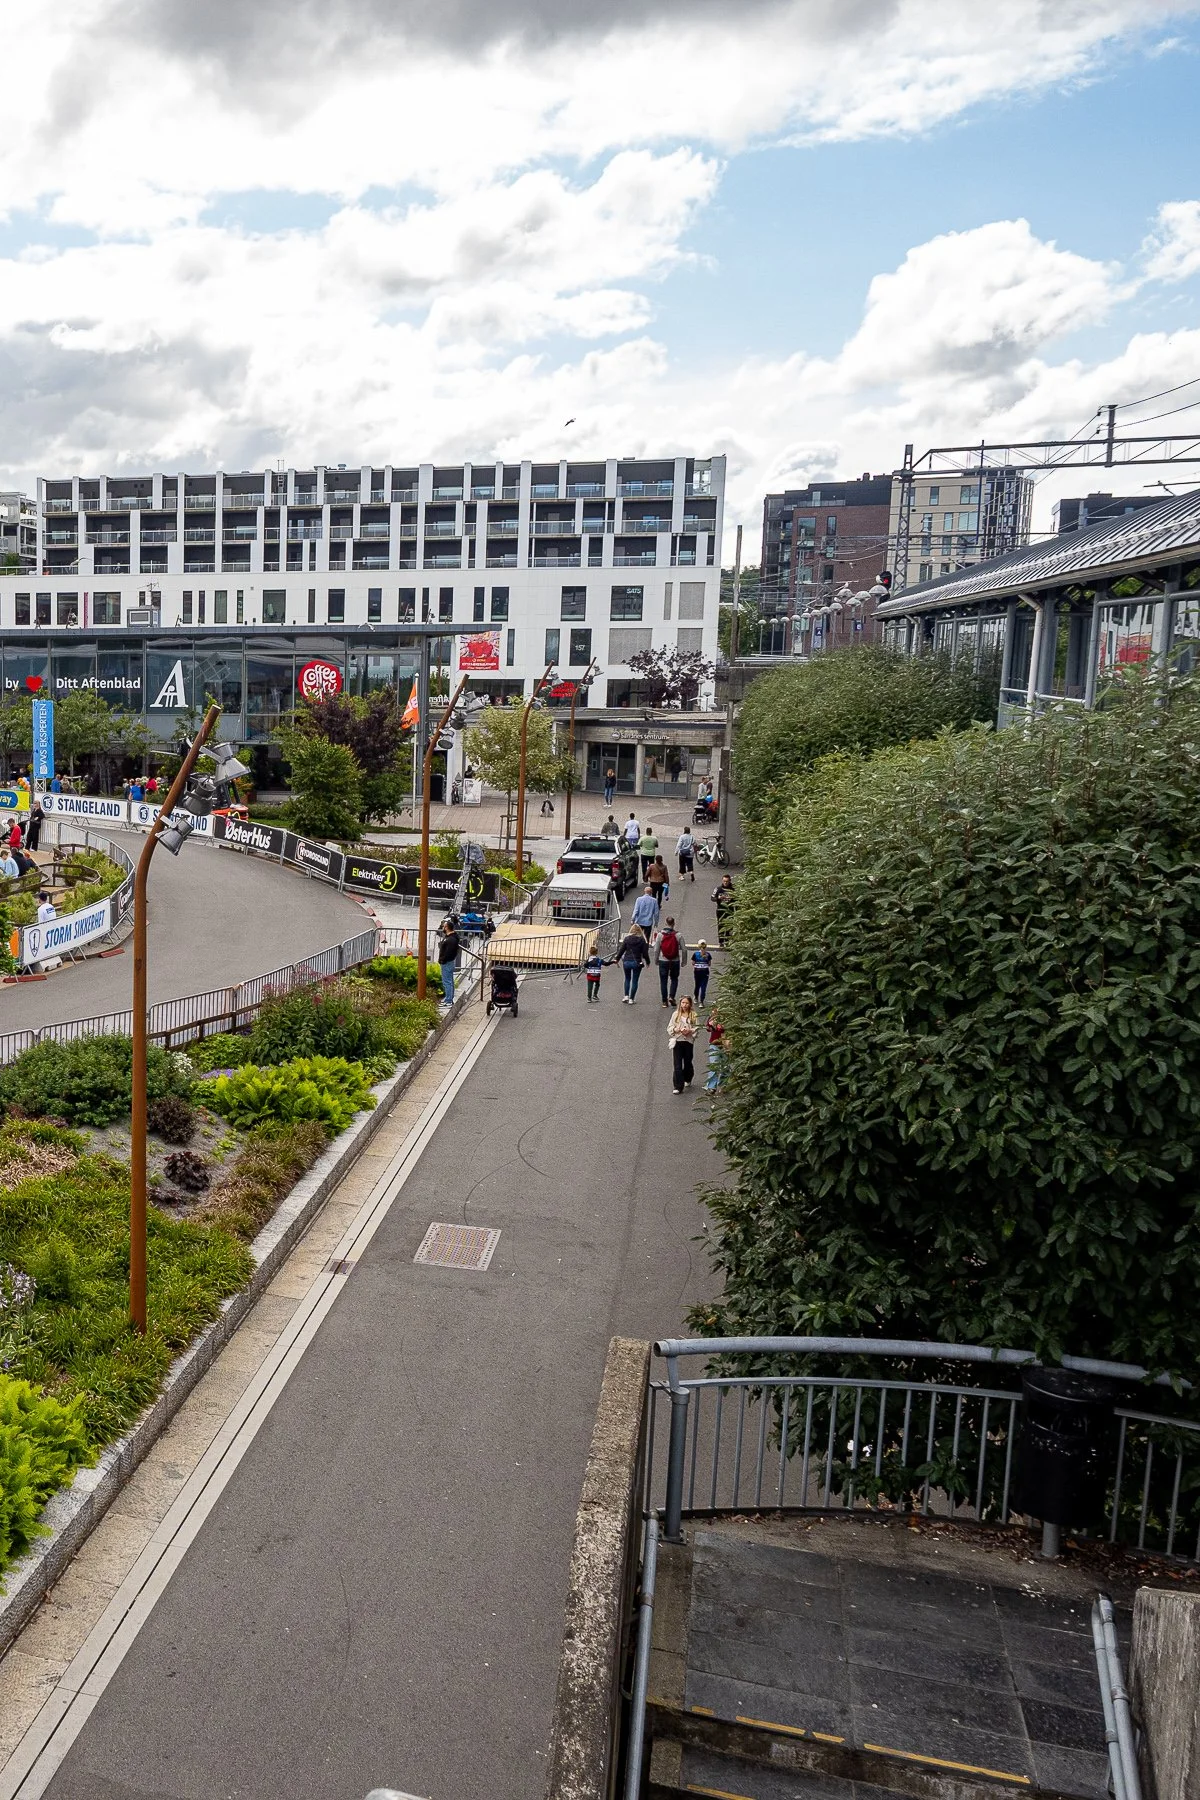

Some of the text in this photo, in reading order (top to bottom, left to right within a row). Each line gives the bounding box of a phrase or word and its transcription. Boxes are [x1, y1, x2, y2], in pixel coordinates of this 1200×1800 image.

[5, 677, 19, 691] by
[56, 677, 79, 689] Ditt
[81, 677, 141, 689] Aftenblad
[39, 751, 47, 766] VVS
[57, 798, 121, 817] STANGELAND
[224, 821, 271, 849] ØsterHus
[352, 867, 392, 885] Elektriker 1
[416, 878, 462, 891] Eektrike
[44, 923, 72, 949] STORM
